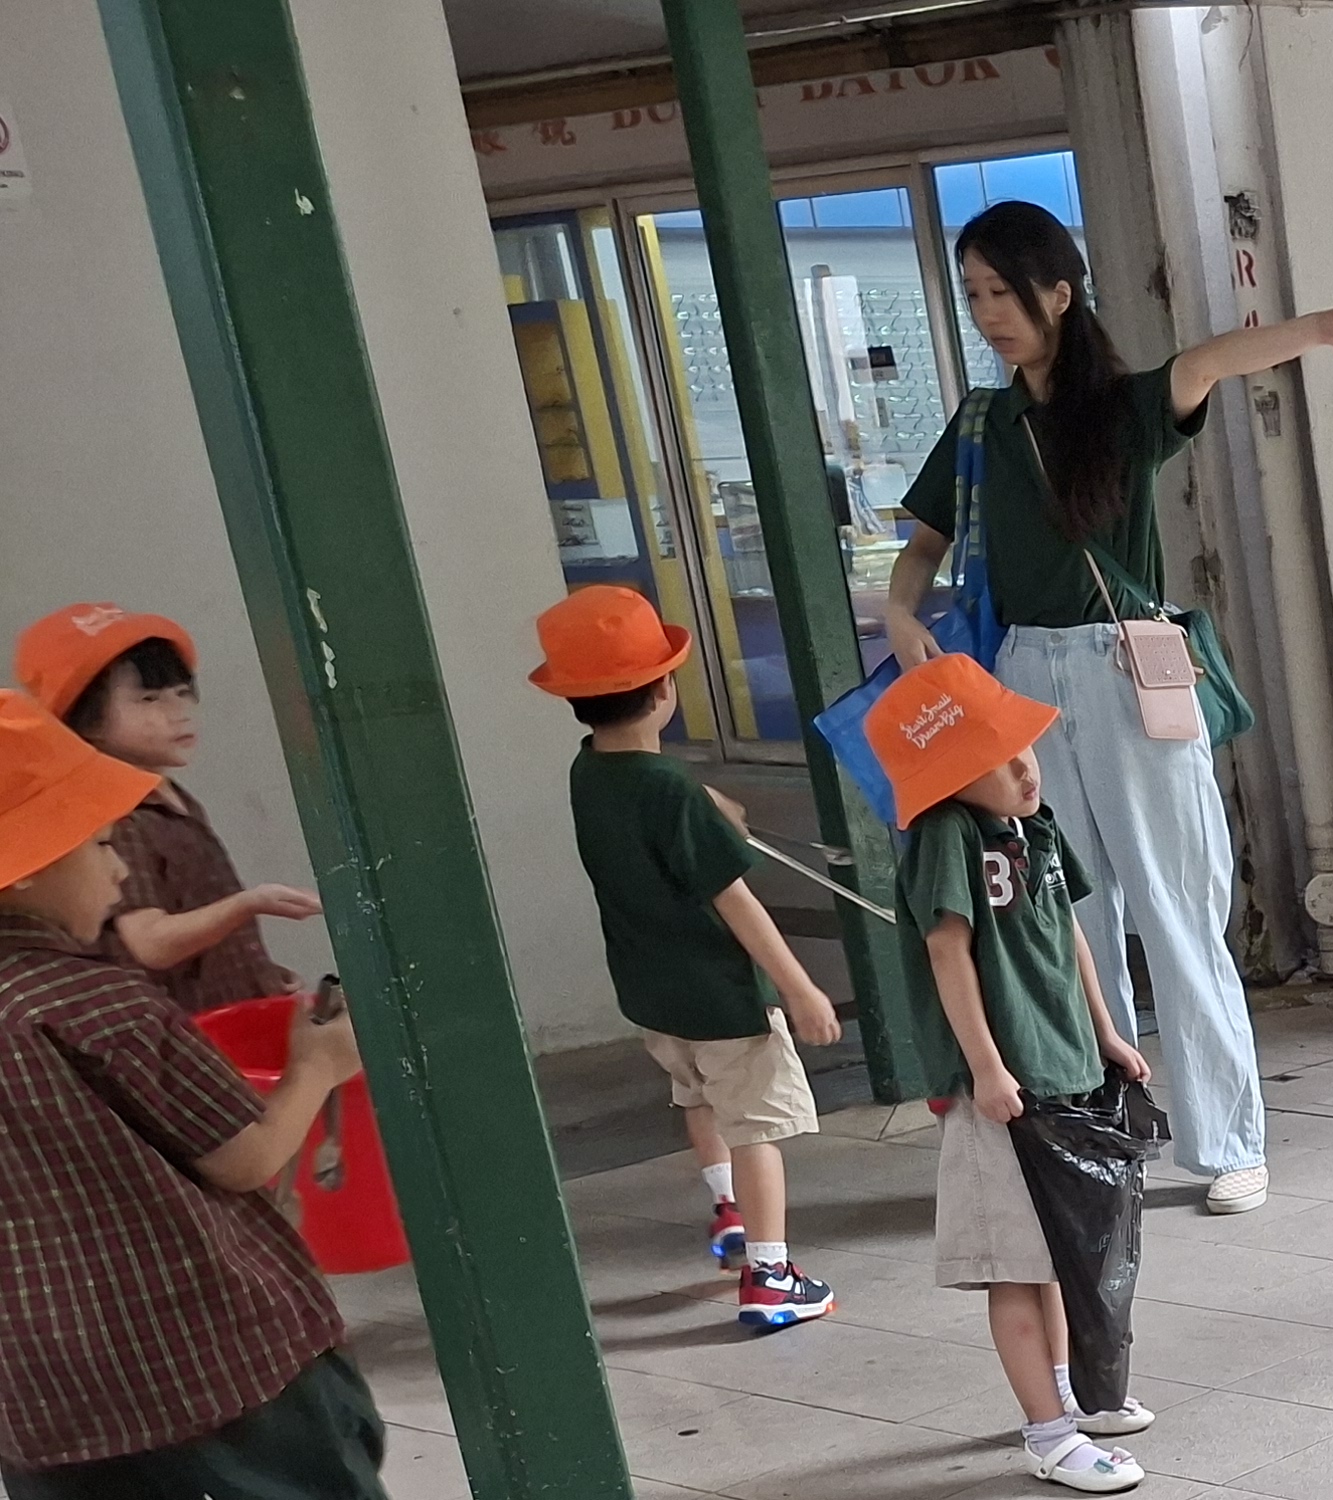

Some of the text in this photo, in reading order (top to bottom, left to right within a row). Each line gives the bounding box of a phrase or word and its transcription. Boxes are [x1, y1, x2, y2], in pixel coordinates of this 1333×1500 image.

[899, 692, 952, 740] Start Small
[911, 704, 965, 749] Dream Big
[982, 851, 1014, 907] 3
